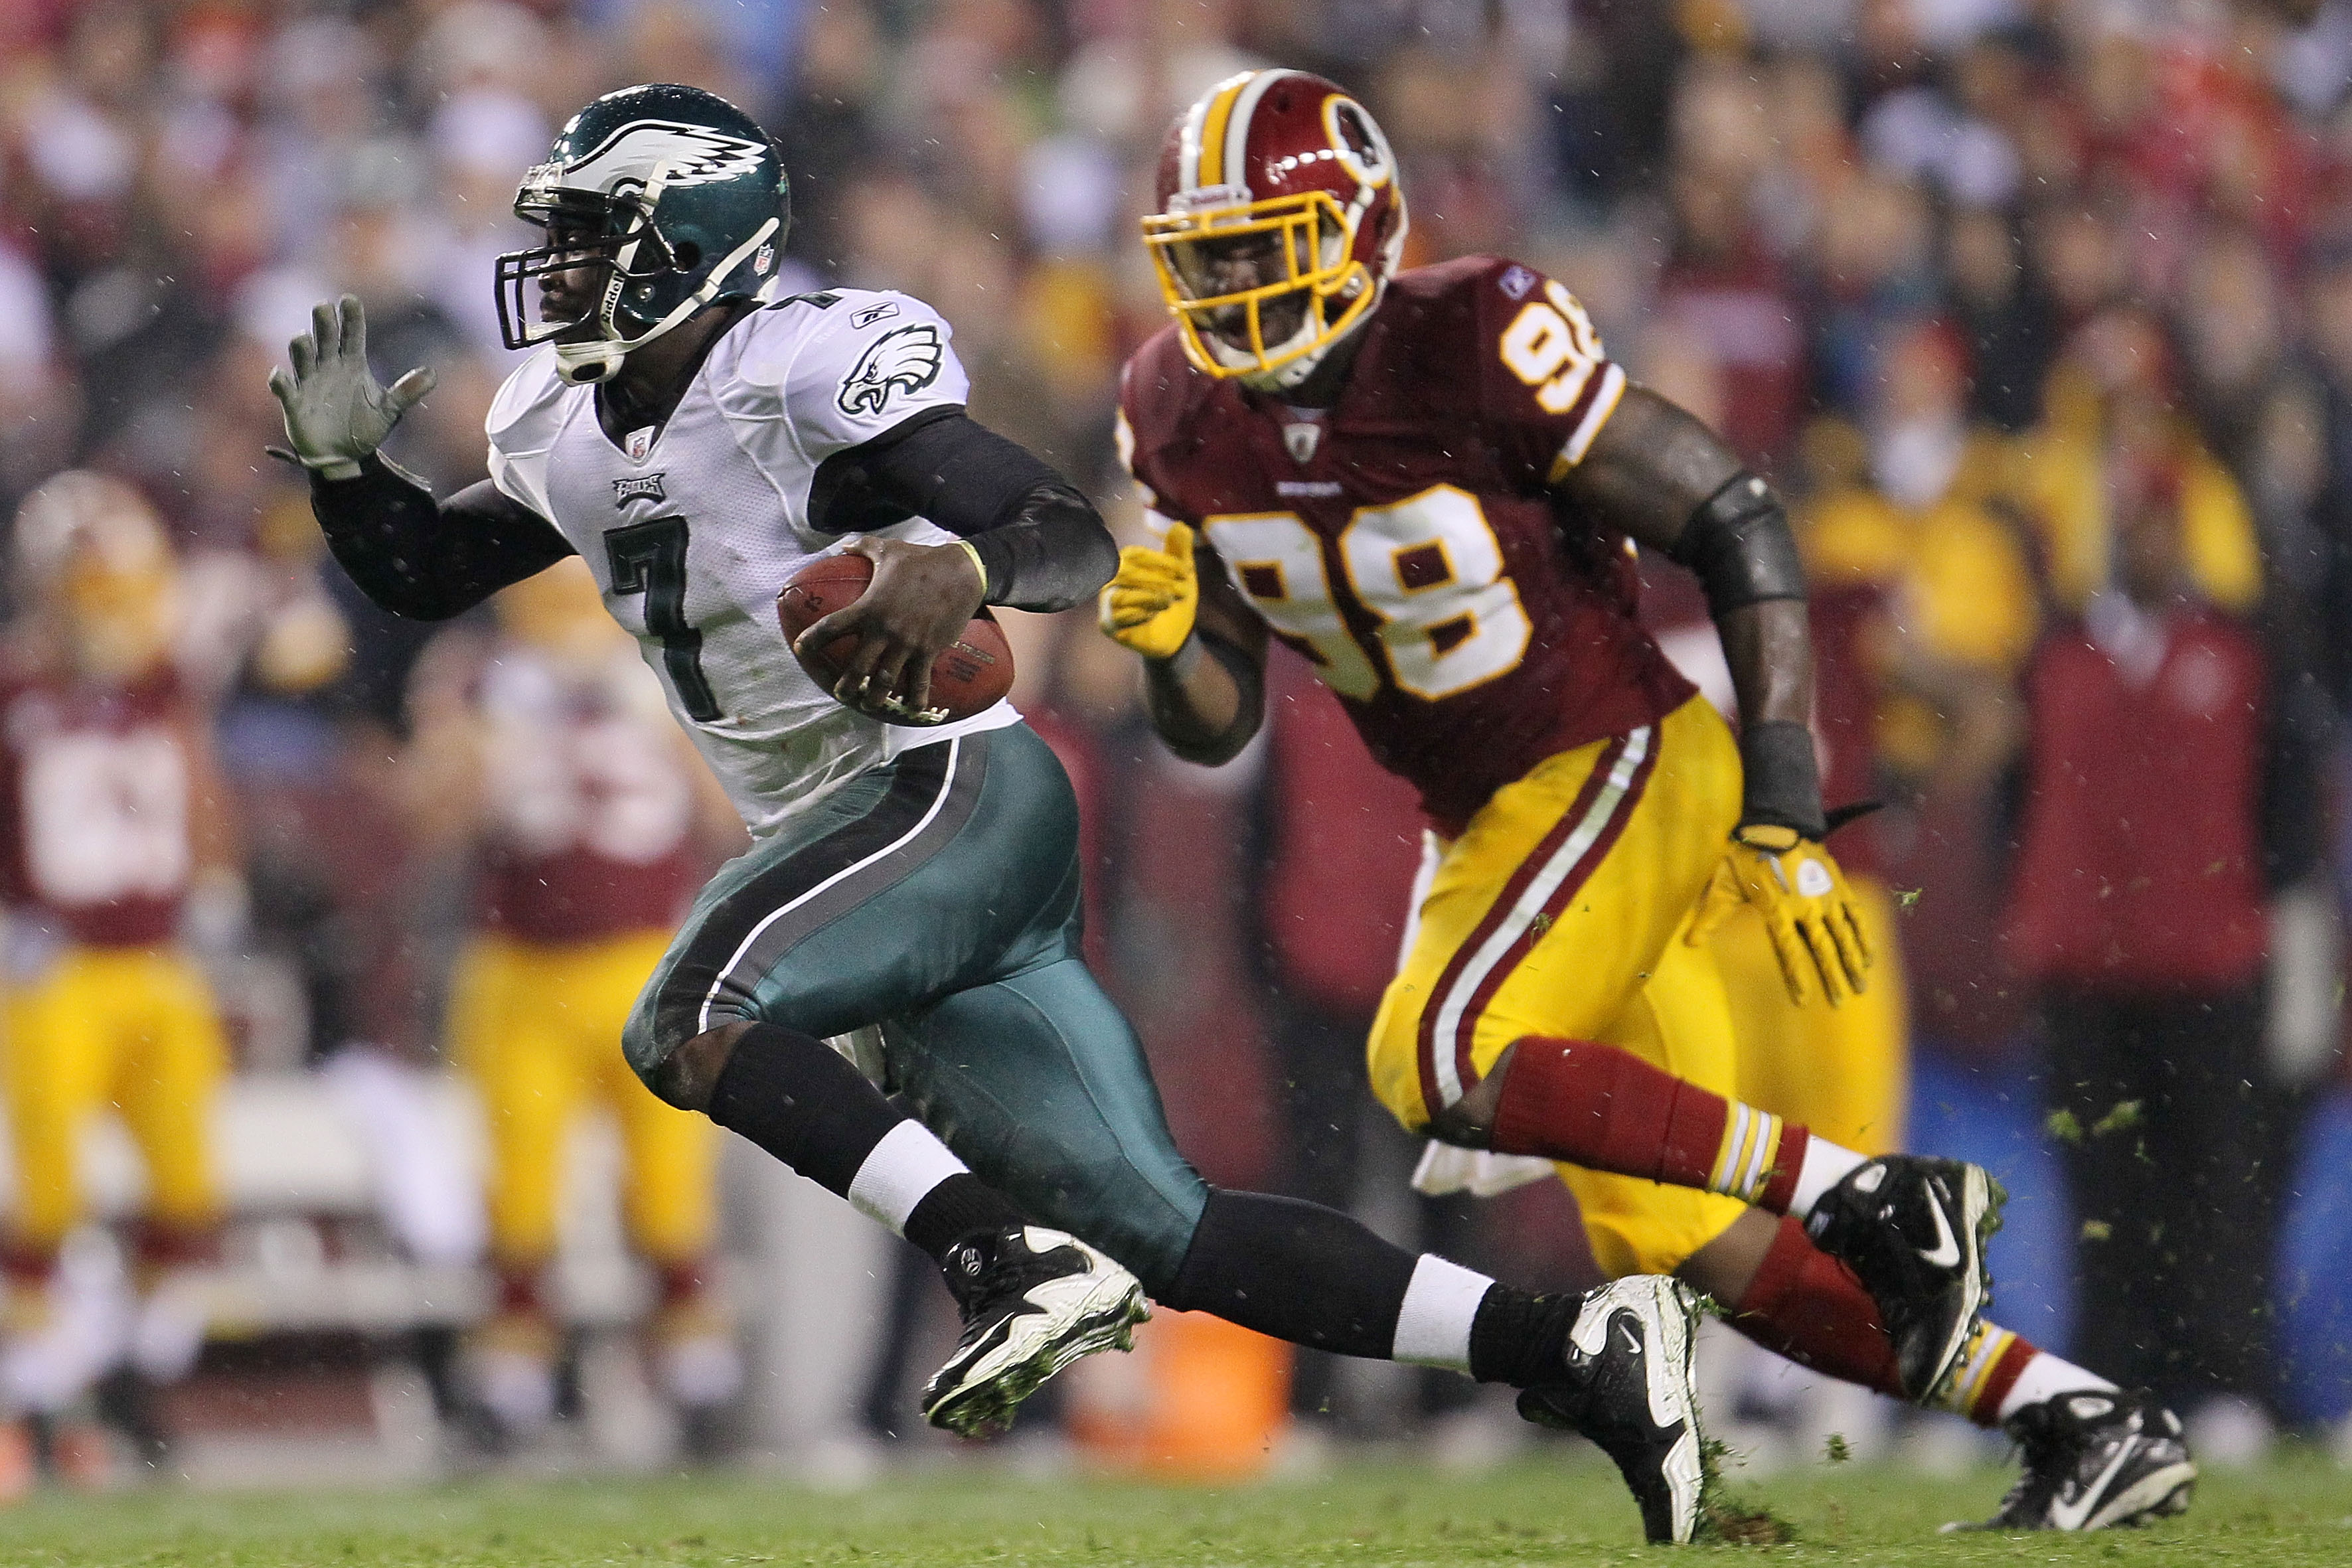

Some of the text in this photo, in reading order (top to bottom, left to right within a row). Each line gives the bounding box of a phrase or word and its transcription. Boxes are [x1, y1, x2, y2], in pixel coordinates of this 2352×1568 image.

[600, 272, 624, 324] Riddell
[603, 514, 724, 722] 7
[1202, 483, 1533, 702] 98
